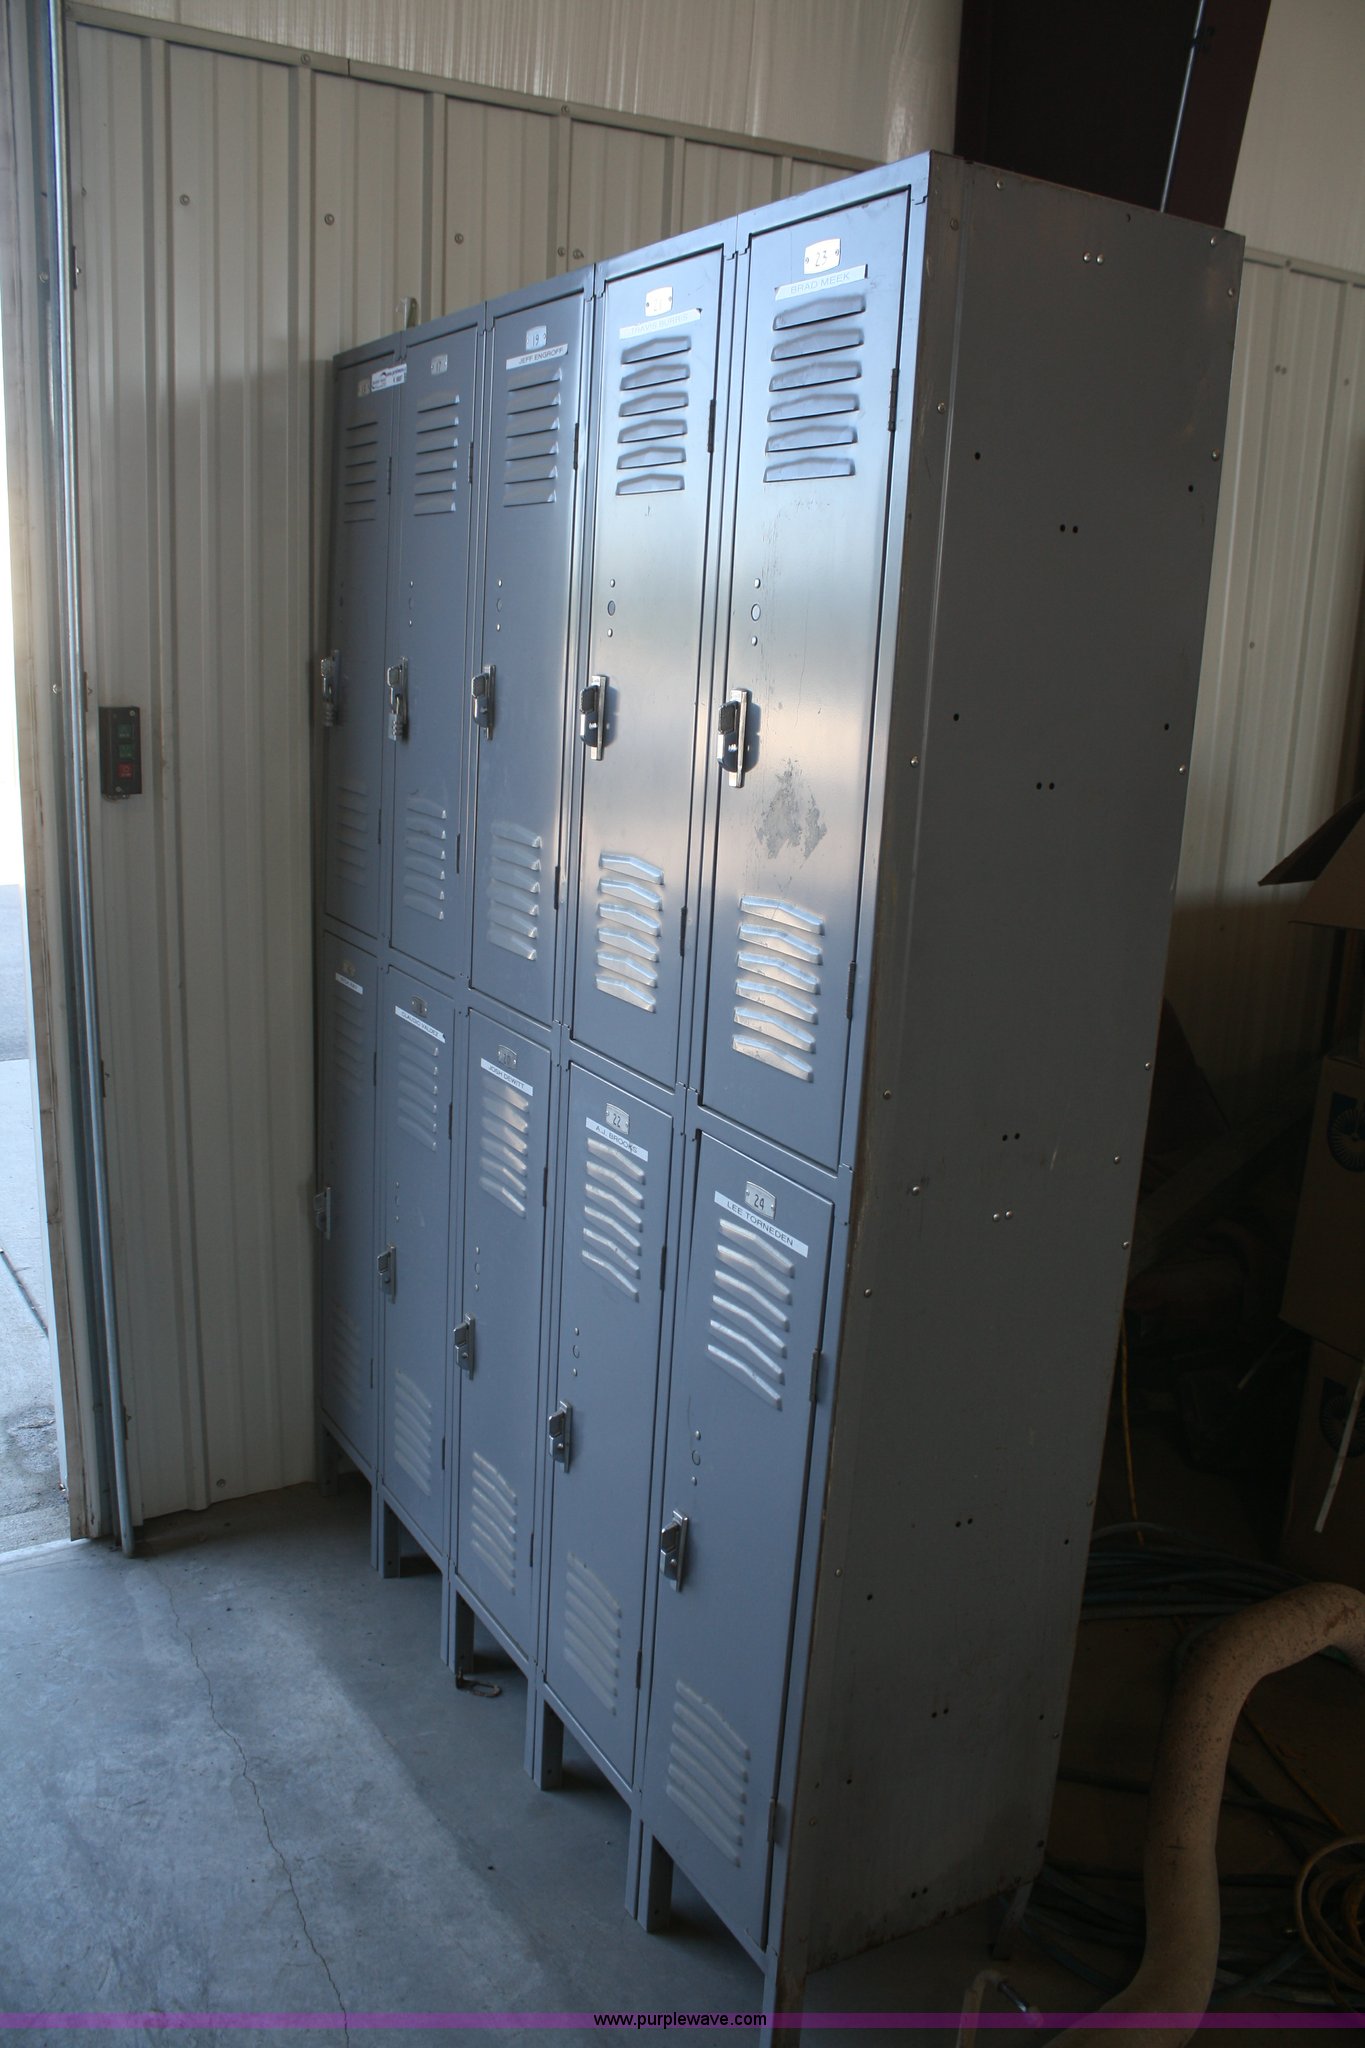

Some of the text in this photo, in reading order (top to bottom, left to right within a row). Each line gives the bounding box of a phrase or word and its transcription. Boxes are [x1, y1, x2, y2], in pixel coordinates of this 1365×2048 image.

[814, 249, 828, 267] 23
[790, 272, 850, 295] BRAD MEEK
[532, 333, 540, 347] 19
[518, 355, 533, 365] JEFF
[503, 1073, 525, 1089] DEWITT
[612, 1112, 622, 1129] 22
[608, 1130, 639, 1154] BROOKS
[753, 1193, 766, 1211] 24
[726, 1200, 795, 1247] LEE TORNEDEN
